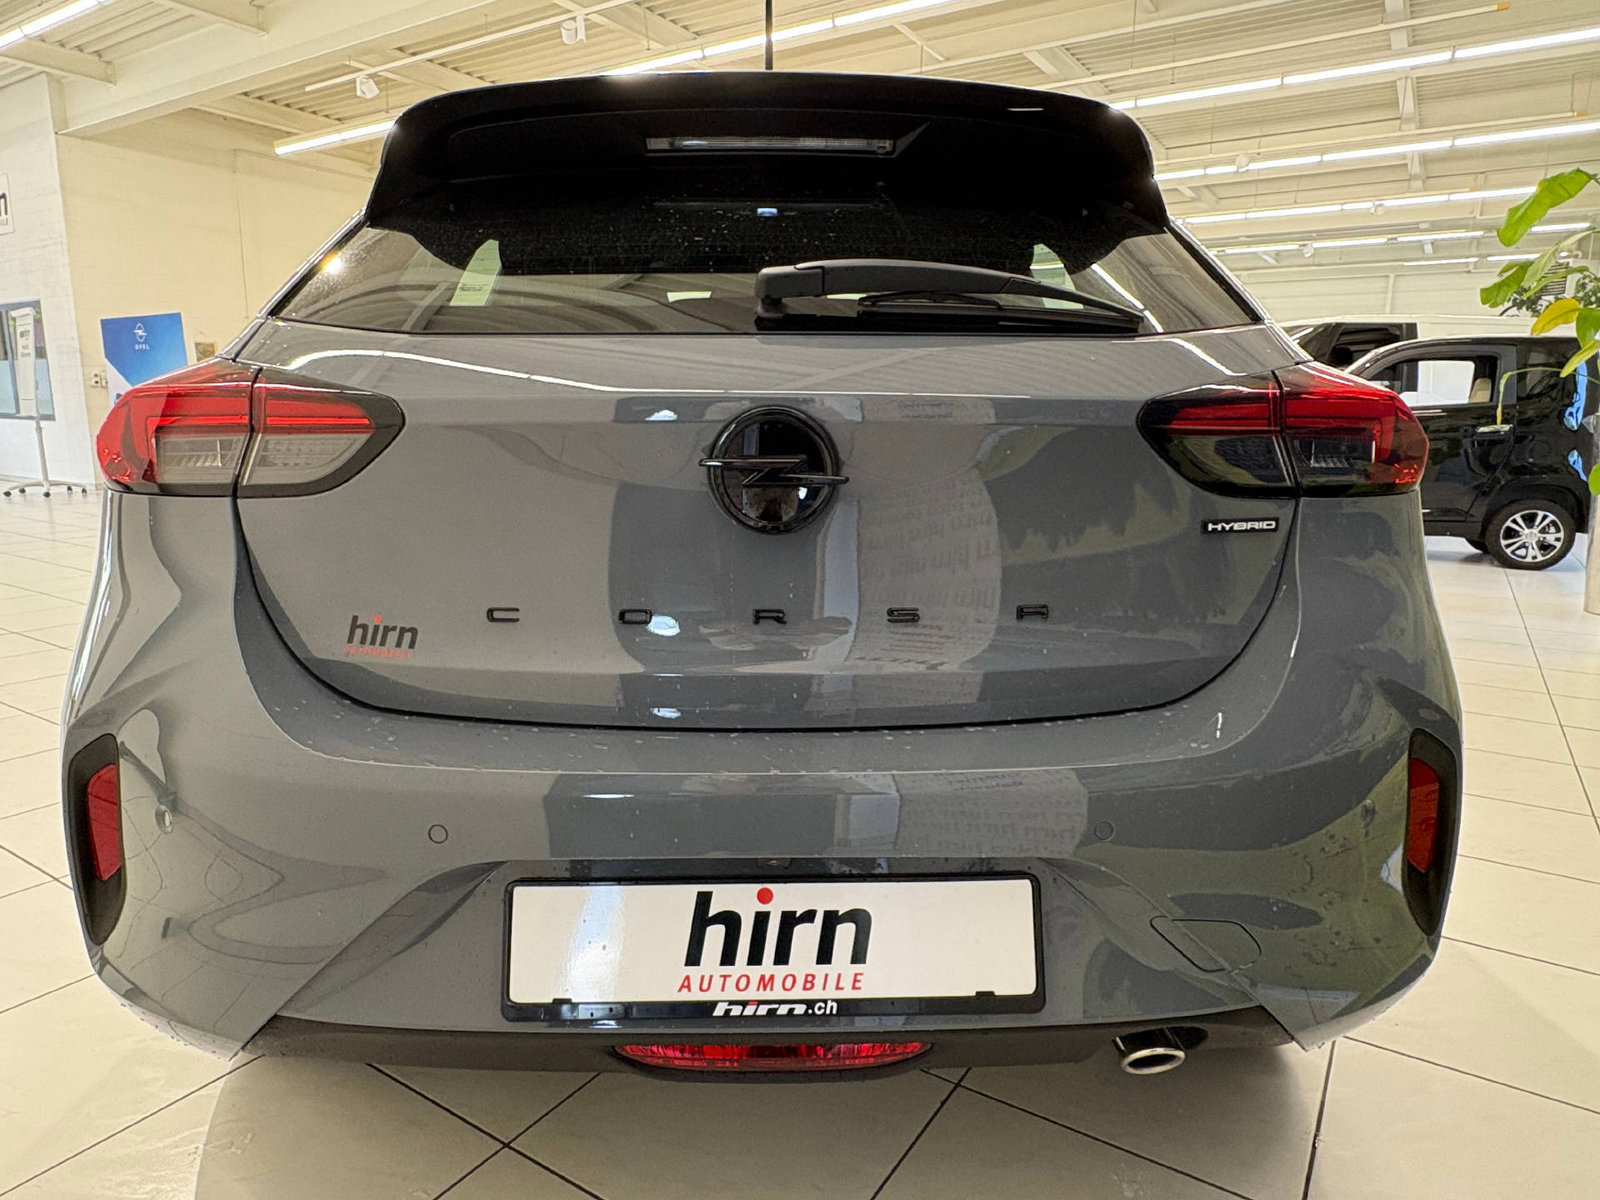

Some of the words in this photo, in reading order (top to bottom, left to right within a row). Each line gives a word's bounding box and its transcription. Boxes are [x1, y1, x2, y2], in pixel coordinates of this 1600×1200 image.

[1208, 521, 1276, 531] HYBRID
[486, 604, 1050, 624] CORSA
[347, 615, 418, 649] hirn
[684, 887, 873, 967] hirn
[678, 972, 865, 993] AUTOMOBILE
[712, 1000, 838, 1016] hirn.ch
